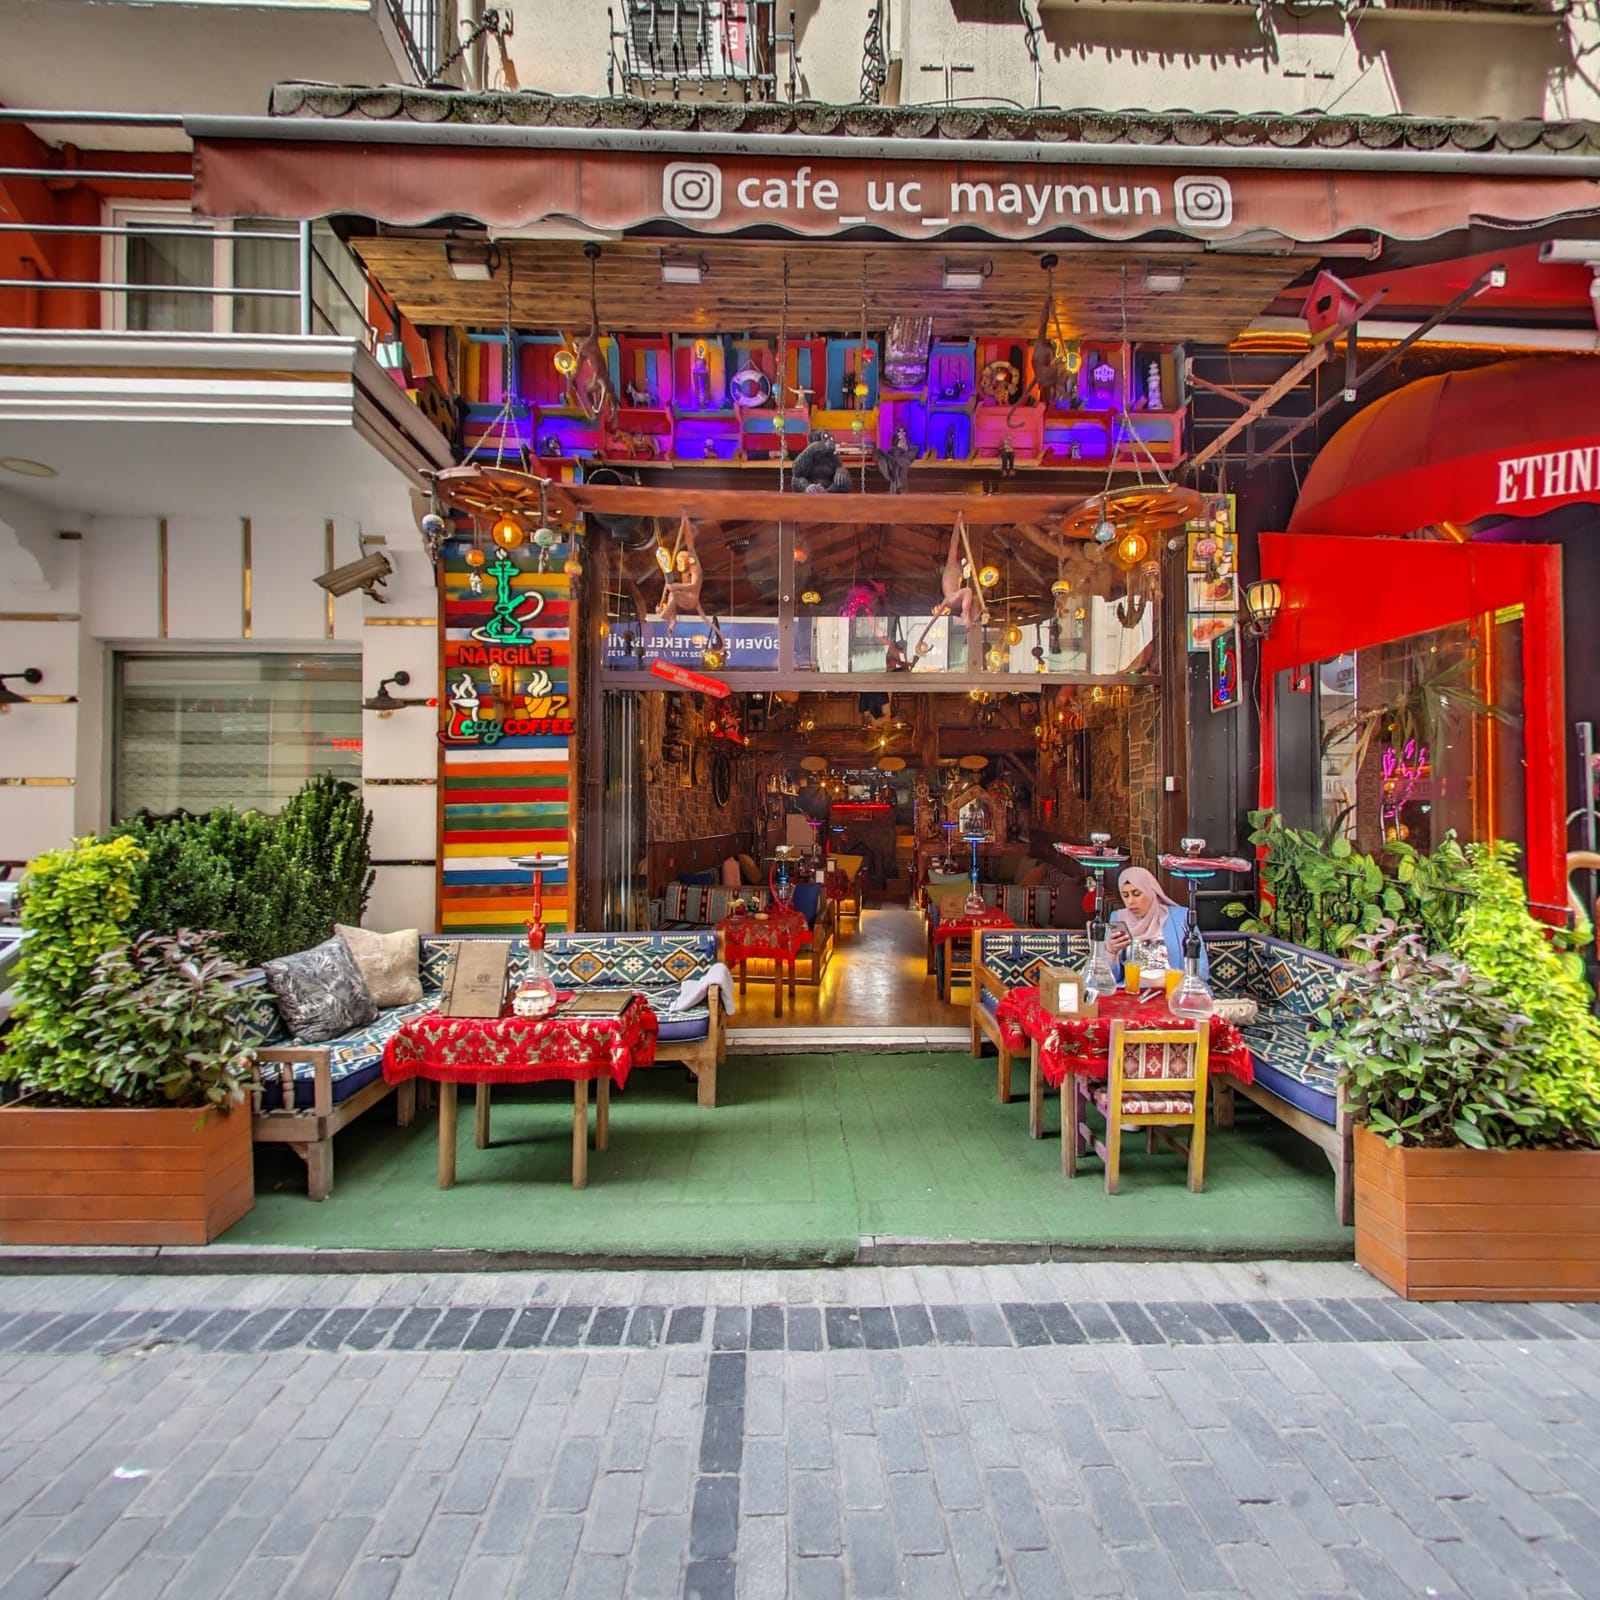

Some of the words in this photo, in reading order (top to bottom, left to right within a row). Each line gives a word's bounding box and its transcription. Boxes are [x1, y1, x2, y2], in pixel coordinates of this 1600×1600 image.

[737, 166, 1161, 226] cafe_uc_maymun
[459, 645, 551, 665] NARGİLE
[503, 719, 574, 735] COFFEE
